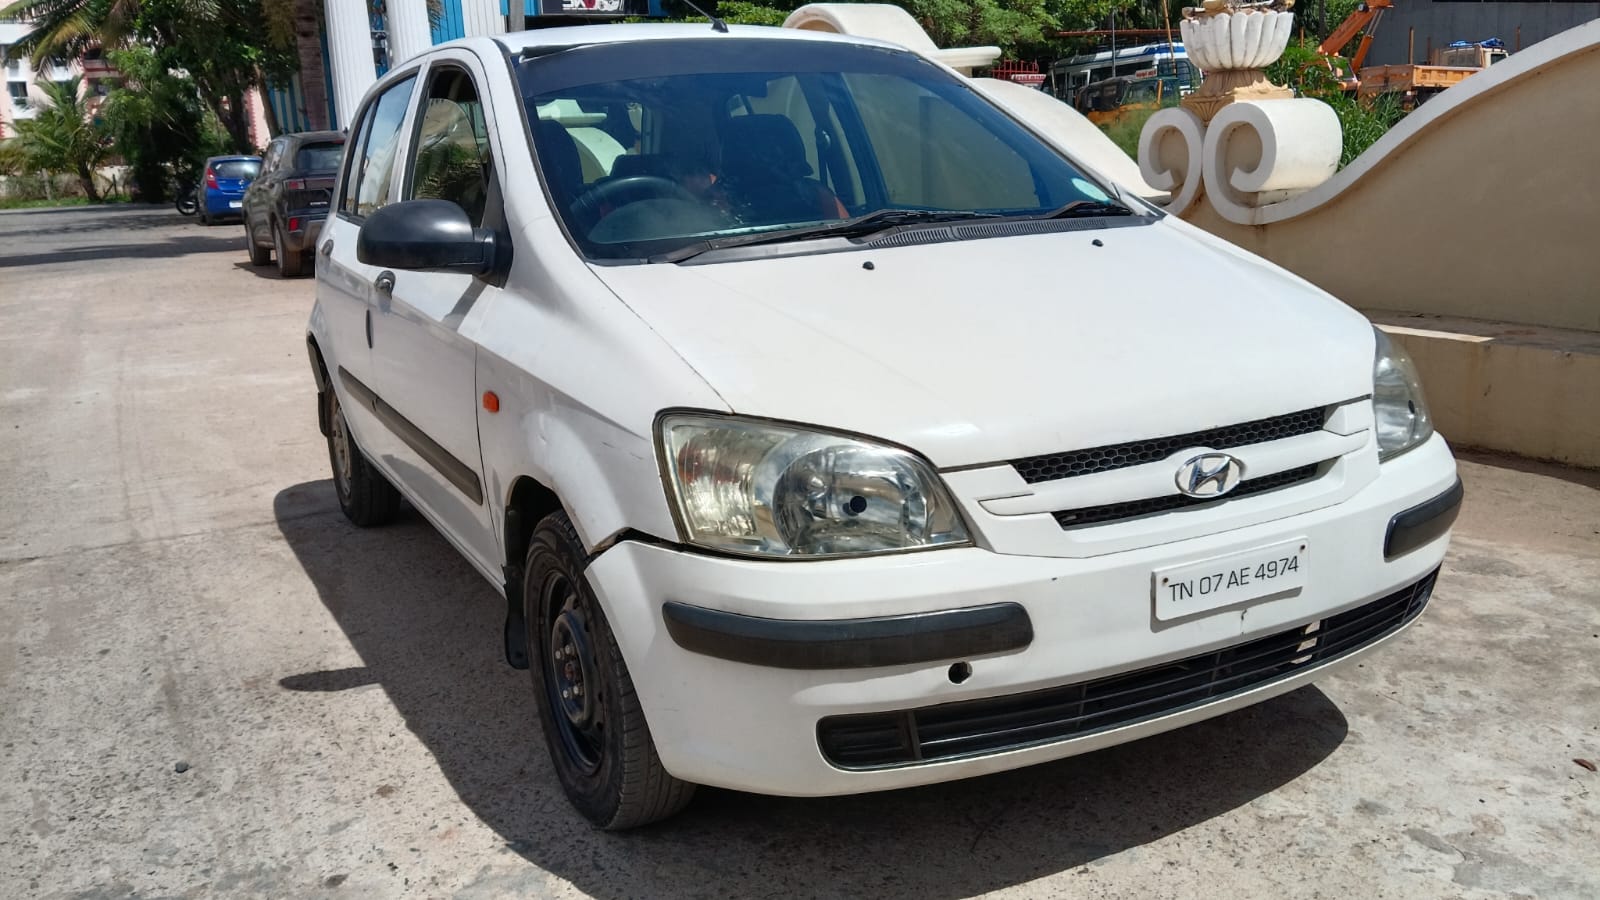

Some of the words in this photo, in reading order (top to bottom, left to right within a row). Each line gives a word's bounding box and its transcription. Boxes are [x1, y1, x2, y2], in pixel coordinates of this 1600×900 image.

[1169, 580, 1193, 602] TN
[1199, 573, 1224, 595] 07
[1226, 567, 1251, 589] AE
[1254, 555, 1299, 580] 4974
